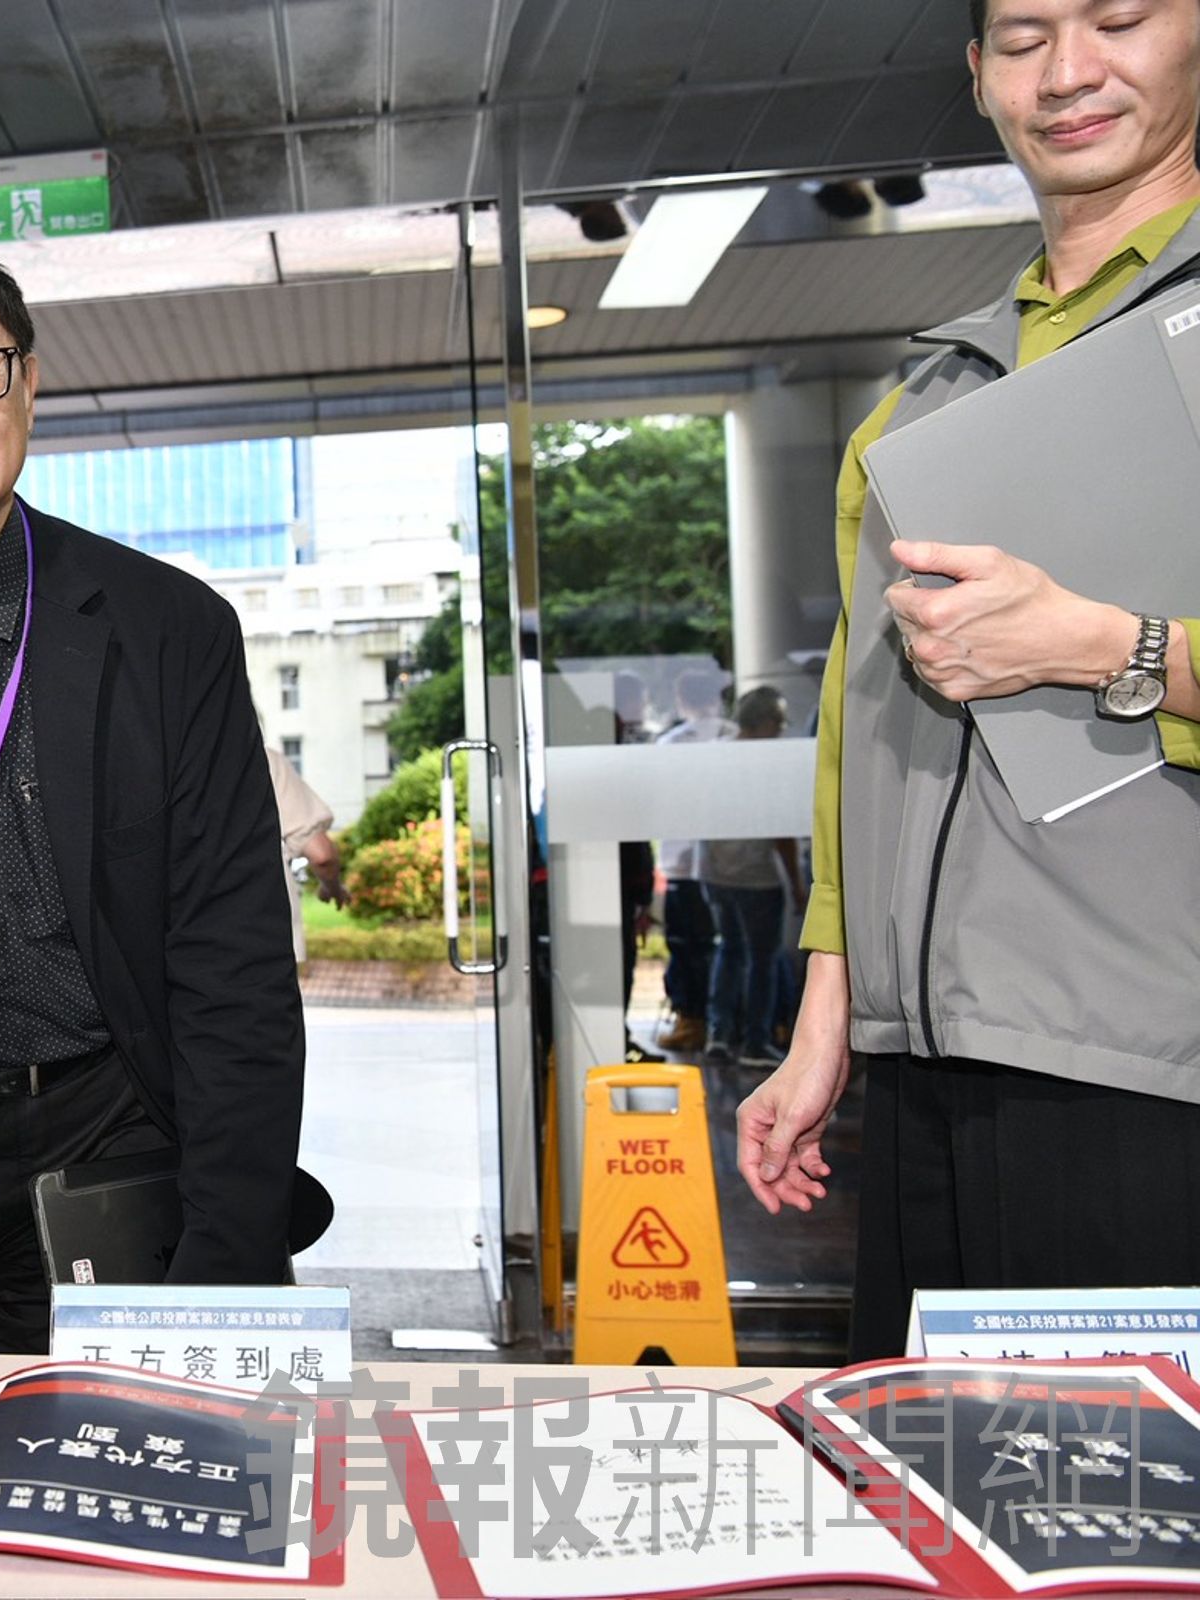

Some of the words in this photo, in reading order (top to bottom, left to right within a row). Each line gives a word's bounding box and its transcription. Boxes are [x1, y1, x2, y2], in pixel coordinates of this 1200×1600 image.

[619, 1139, 670, 1155] WET
[606, 1159, 685, 1175] FLOOR
[608, 1280, 701, 1300] 小心地滑
[972, 1314, 1198, 1330] 全國性公民投票案第21案意見發表會
[77, 1422, 186, 1455] 簽到
[16, 1437, 240, 1483] 正方代表人
